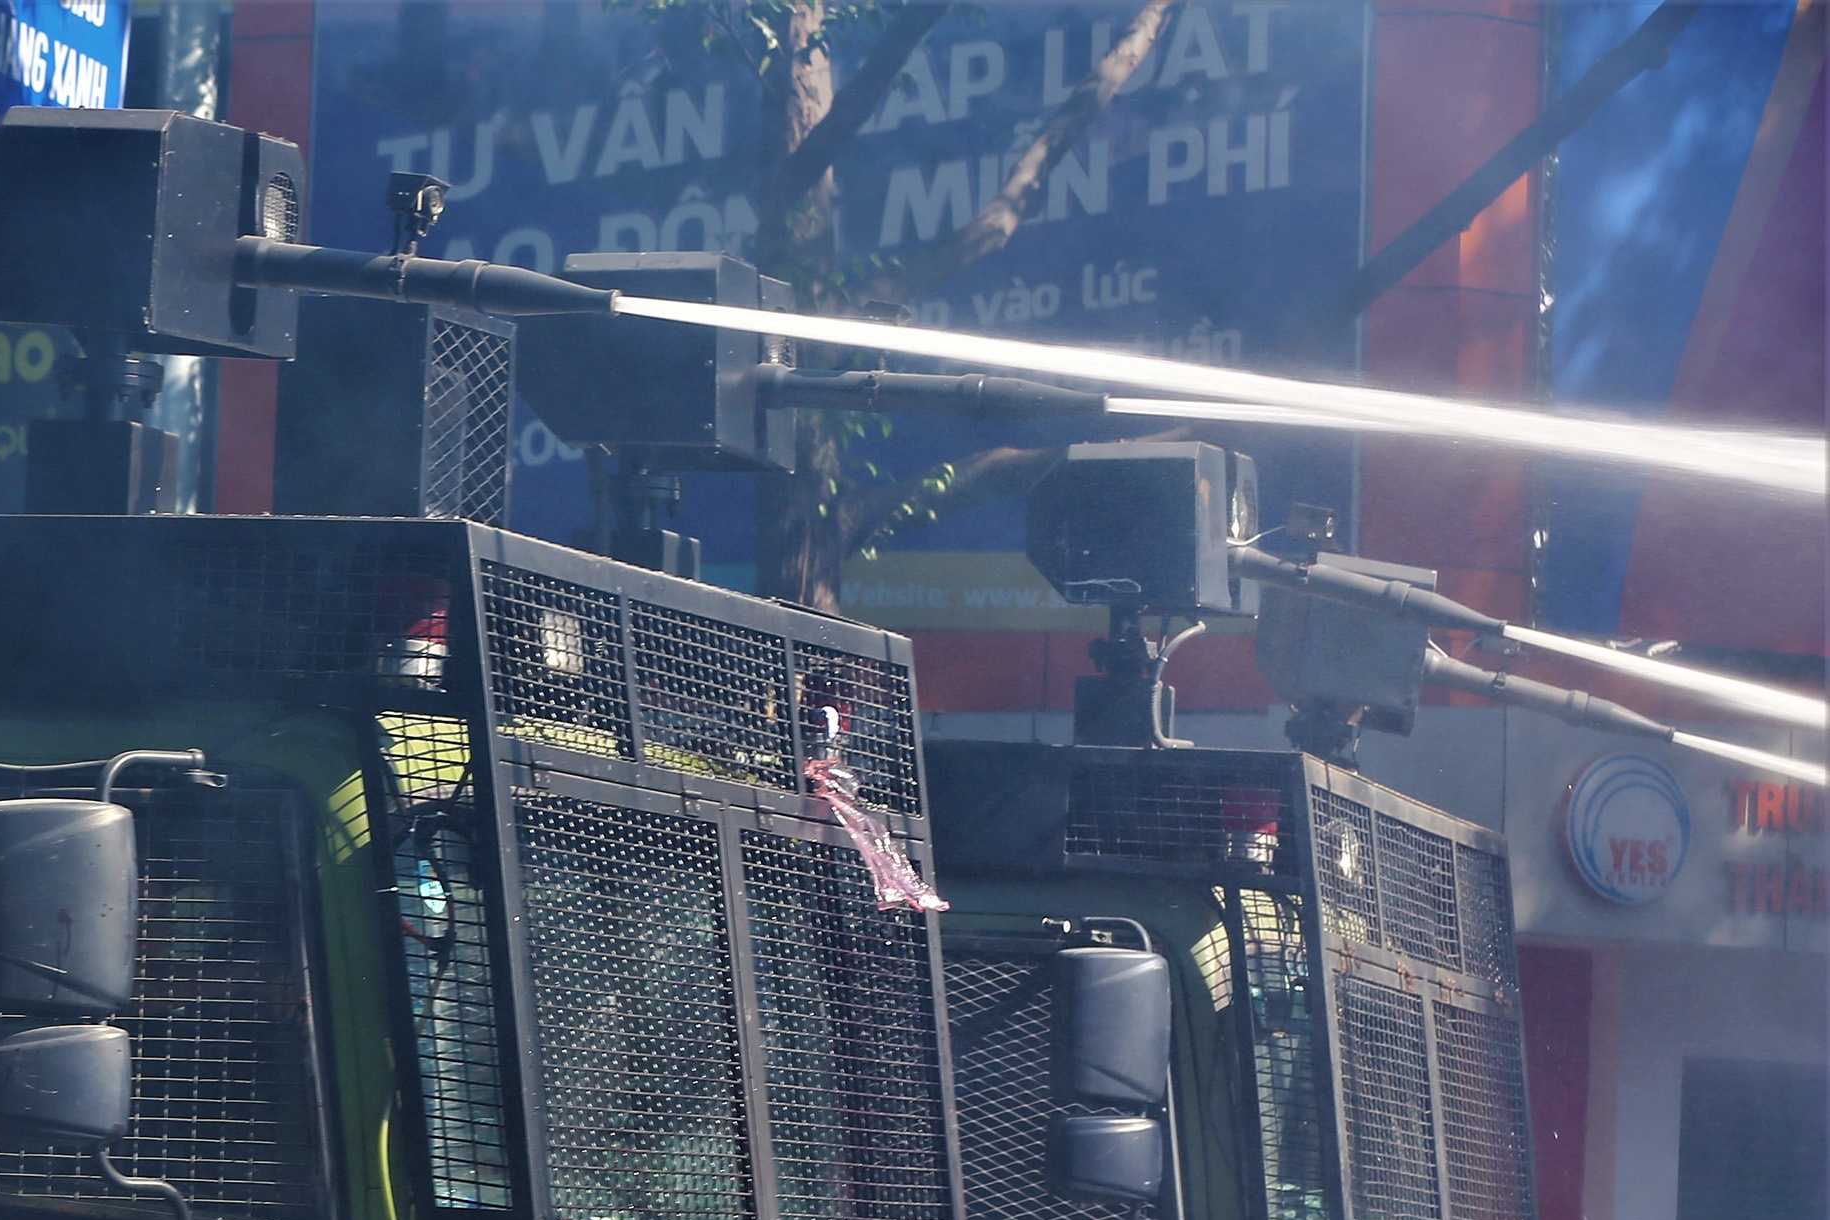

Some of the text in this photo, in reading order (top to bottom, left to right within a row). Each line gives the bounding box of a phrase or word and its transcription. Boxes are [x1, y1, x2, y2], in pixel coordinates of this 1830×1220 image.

[49, 40, 108, 109] XANH
[1147, 86, 1298, 206] PHÍ
[972, 276, 1061, 328] vào
[1080, 260, 1158, 311] lúc
[1609, 836, 1669, 875] YES
